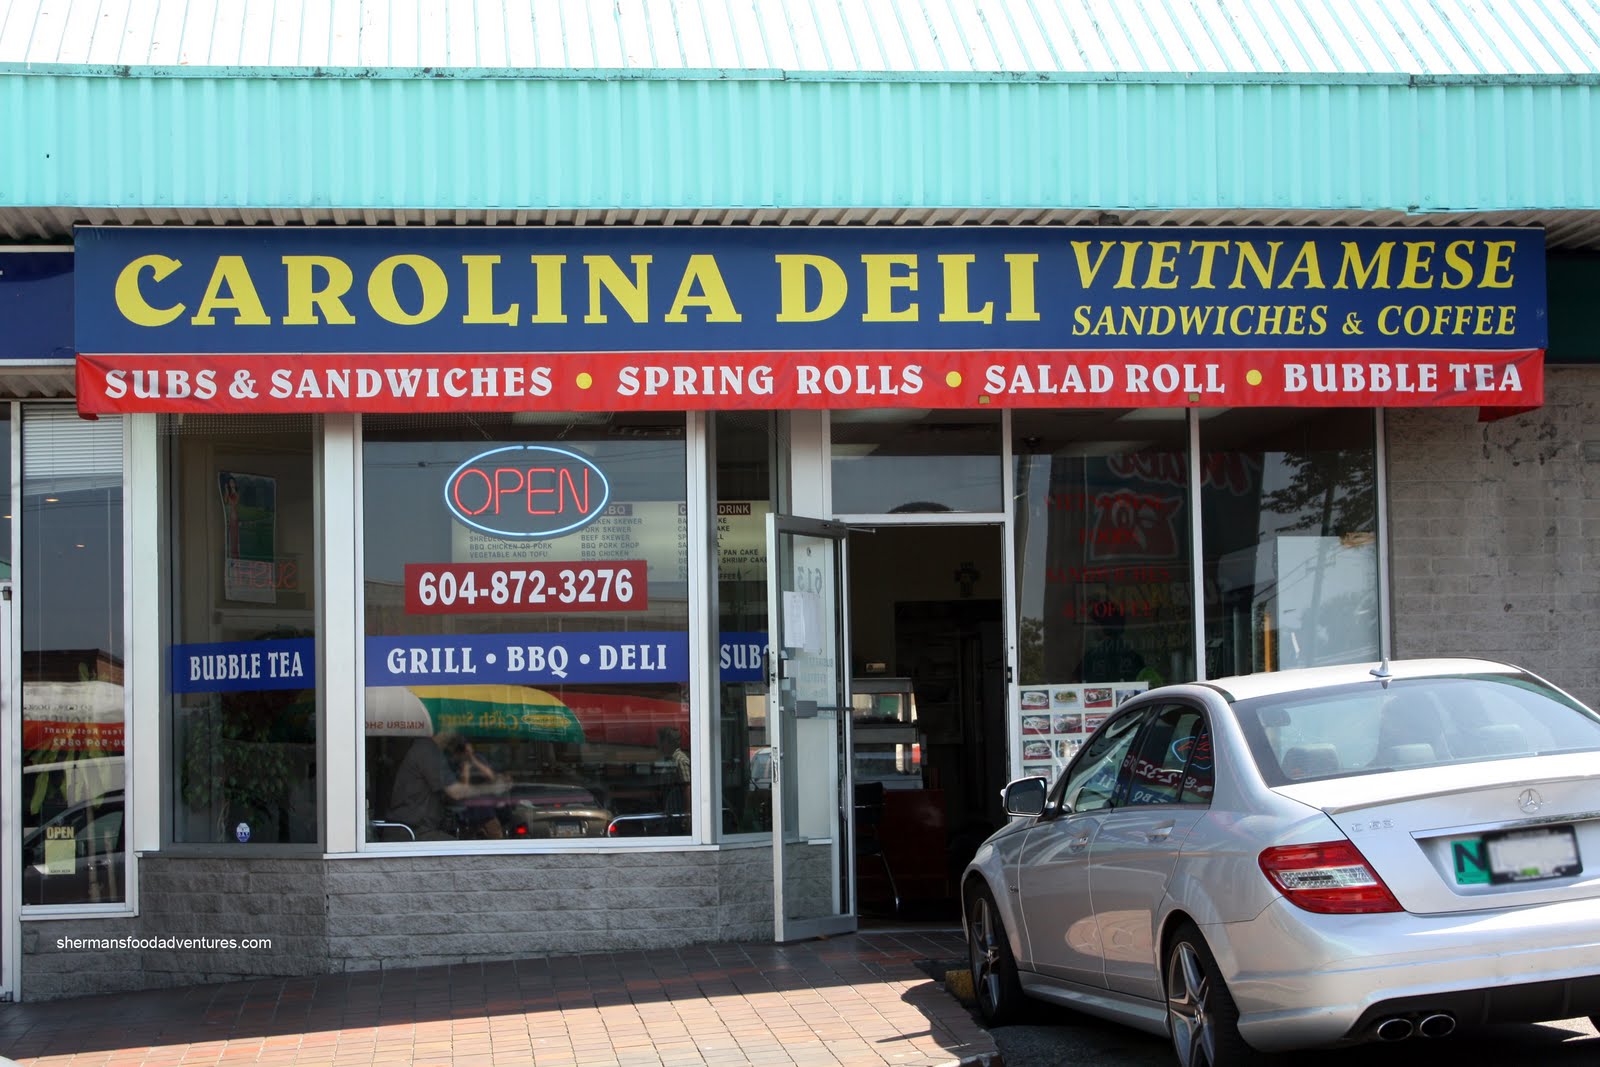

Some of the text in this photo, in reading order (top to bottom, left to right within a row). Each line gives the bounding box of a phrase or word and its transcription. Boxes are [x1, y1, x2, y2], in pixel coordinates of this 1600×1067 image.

[1070, 240, 1516, 290] VIETNAMESE
[115, 253, 1041, 327] CAROLINA DELI
[1071, 304, 1516, 337] SANDWICHES & COFFEE
[104, 366, 553, 401] SUBS & SANDWICHES
[616, 364, 924, 397] SPRING ROLLS
[983, 363, 1226, 396] SALAD ROLL
[1283, 363, 1524, 394] BUBBLE TEA
[453, 467, 590, 517] OPEN
[719, 504, 750, 514] DRINK
[469, 543, 484, 551] BBQ
[533, 542, 552, 550] PORK
[469, 551, 510, 559] VEGETABLE
[530, 550, 549, 558] TOFU
[418, 568, 634, 607] 604-872-3276
[189, 652, 304, 682] BUBBLE TEA
[387, 644, 667, 679] GRILL BBQ DELI
[46, 826, 75, 840] OPEN
[1454, 843, 1487, 873] N
